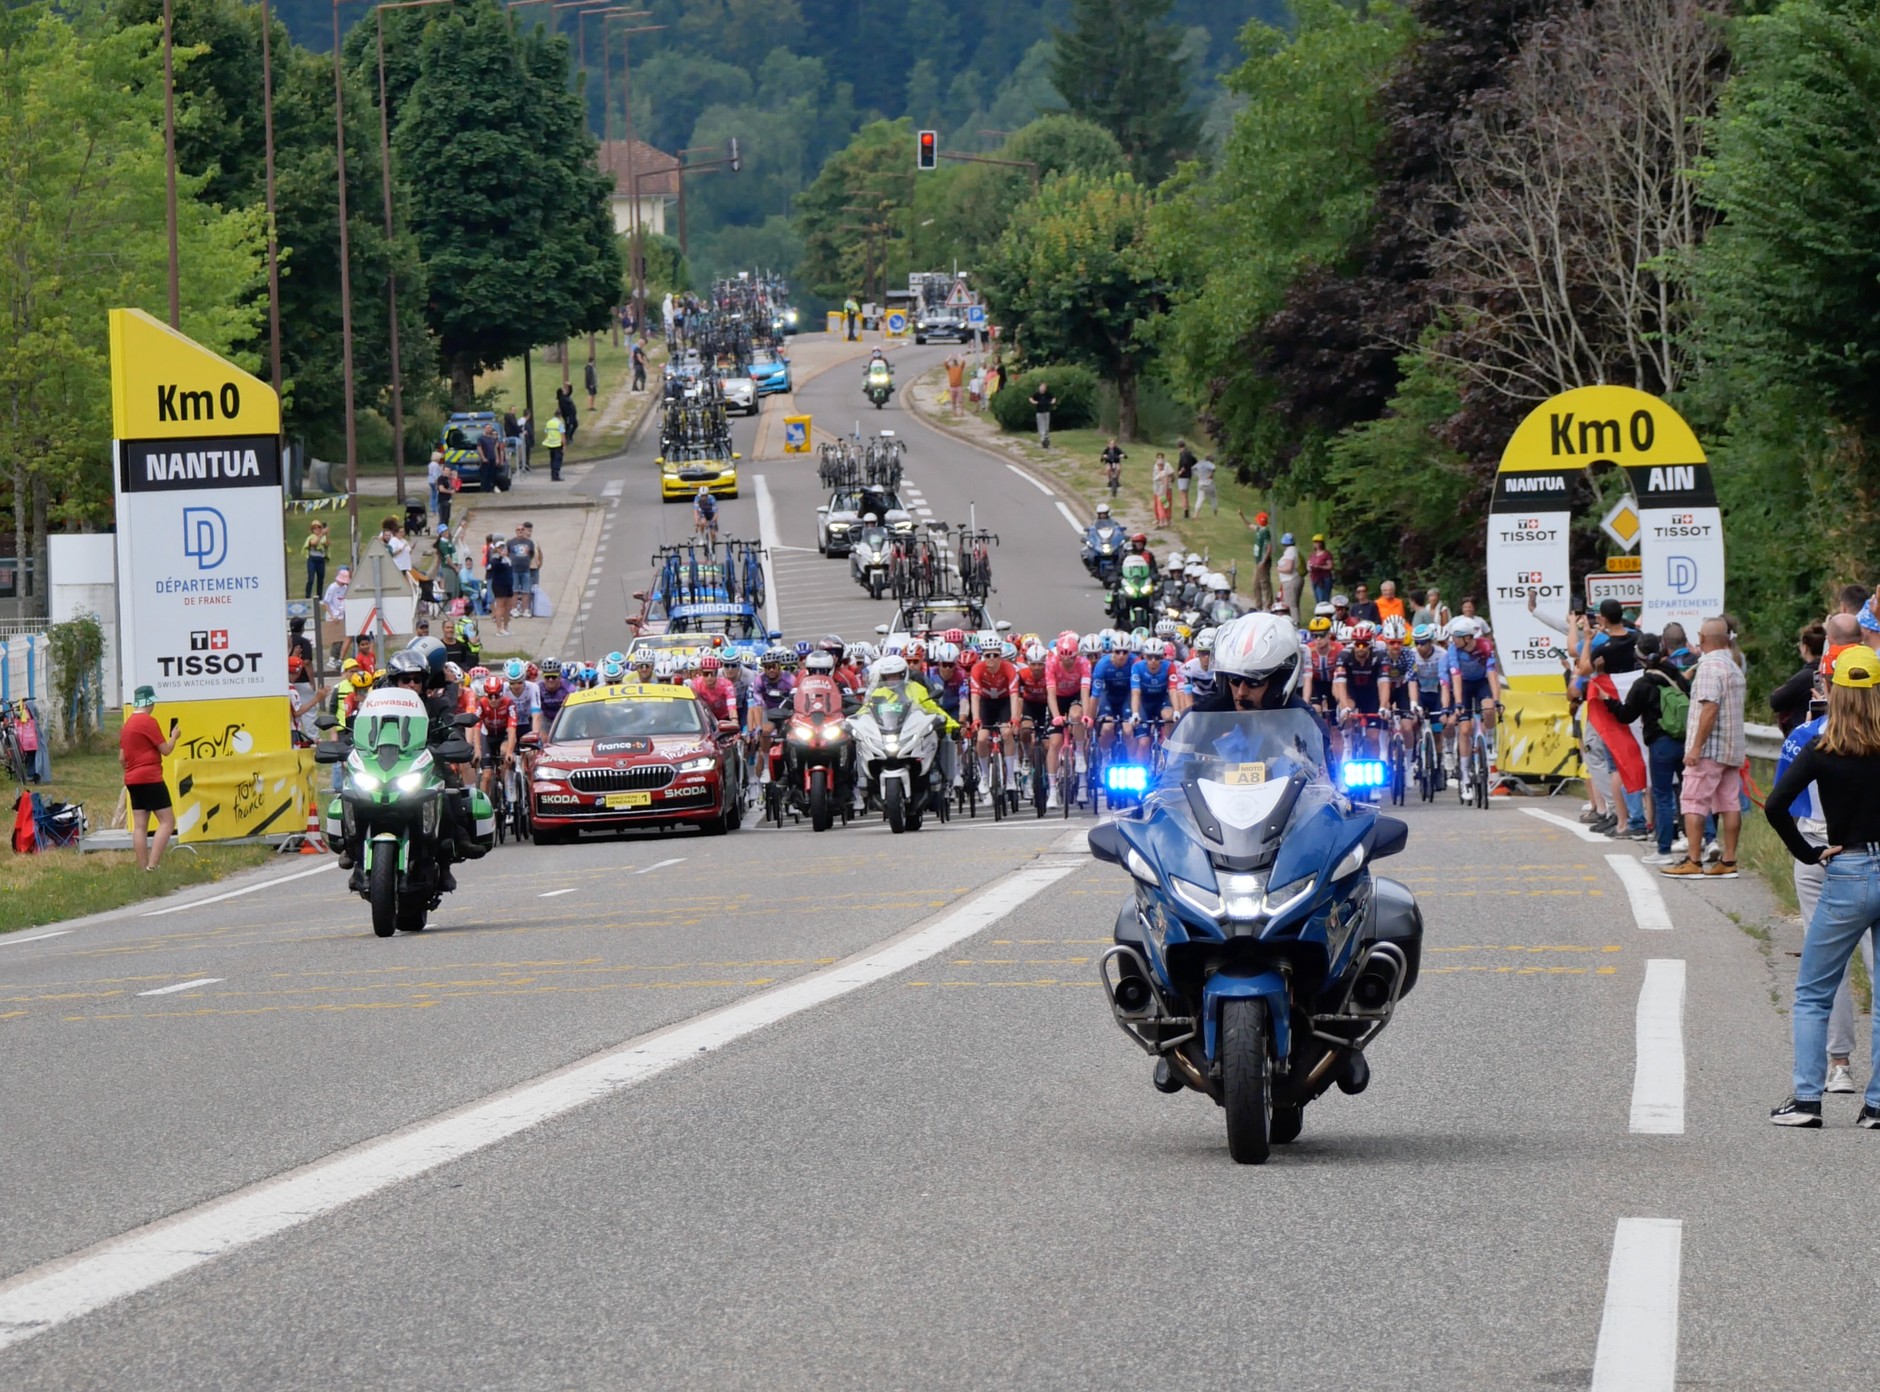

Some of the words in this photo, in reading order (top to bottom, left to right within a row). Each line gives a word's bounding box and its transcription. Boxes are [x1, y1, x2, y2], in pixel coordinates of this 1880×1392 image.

[157, 384, 214, 422] Km
[220, 382, 240, 419] 0
[1550, 412, 1621, 455] Km
[1630, 409, 1655, 452] 0
[146, 449, 260, 481] NANTUA
[1505, 476, 1566, 492] NANTUA
[1648, 466, 1695, 492] AIN
[1500, 531, 1558, 542] TISSOT
[1654, 526, 1711, 537] TISSOT
[1618, 560, 1641, 569] 108
[156, 576, 259, 593] DÉPARTEMENTS
[184, 597, 196, 606] DE
[198, 595, 232, 605] FRANCE
[1648, 598, 1719, 609] DÉPARTEMENTS
[682, 603, 743, 614] SHIMANO
[157, 652, 263, 677] TISSOT
[157, 680, 181, 689] SWISS
[183, 679, 220, 687] WATCHES
[222, 677, 245, 685] SINCE
[248, 676, 265, 684] 1853
[609, 685, 652, 696] LCL
[366, 699, 418, 708] Kawasaki
[1237, 772, 1260, 783] A8
[664, 785, 707, 798] SKODA
[541, 795, 580, 804] SKODA
